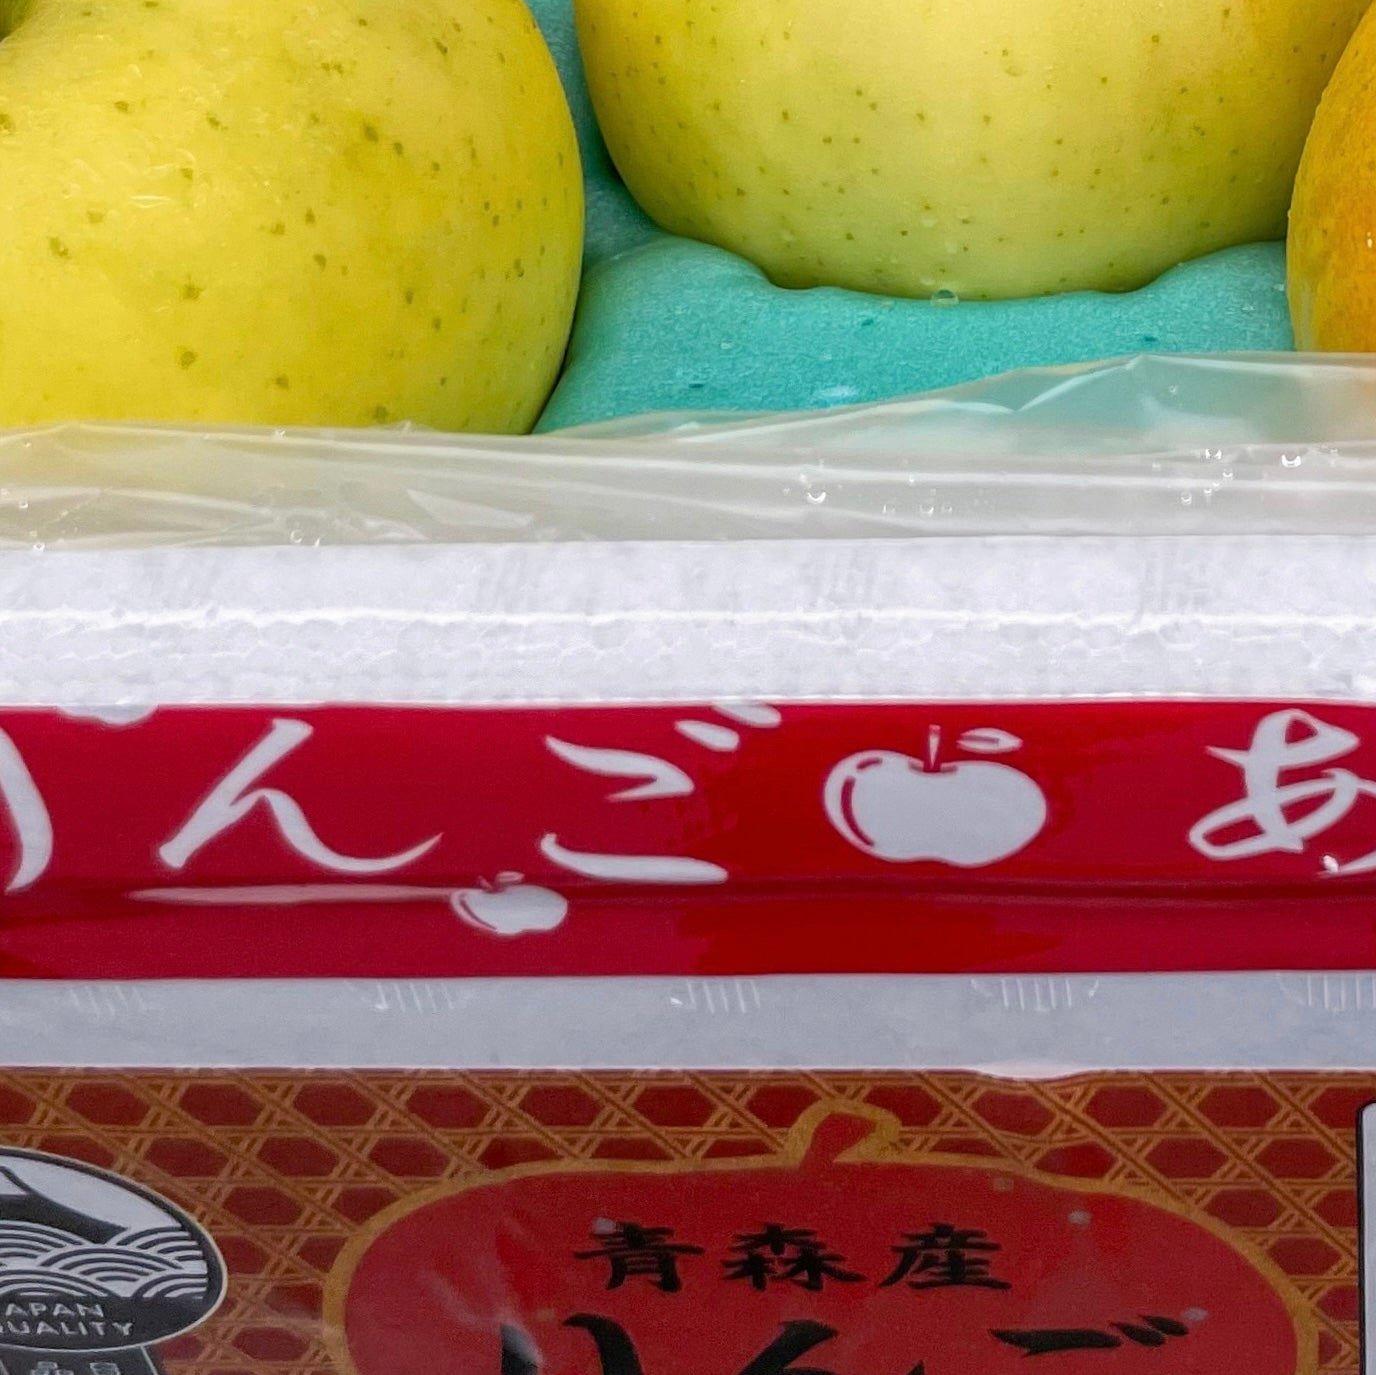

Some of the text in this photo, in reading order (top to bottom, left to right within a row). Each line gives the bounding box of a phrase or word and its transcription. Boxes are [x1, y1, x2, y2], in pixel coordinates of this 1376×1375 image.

[574, 1223, 1012, 1293] 青森産
[5, 1302, 104, 1317] APAN
[0, 1321, 133, 1336] UALITY
